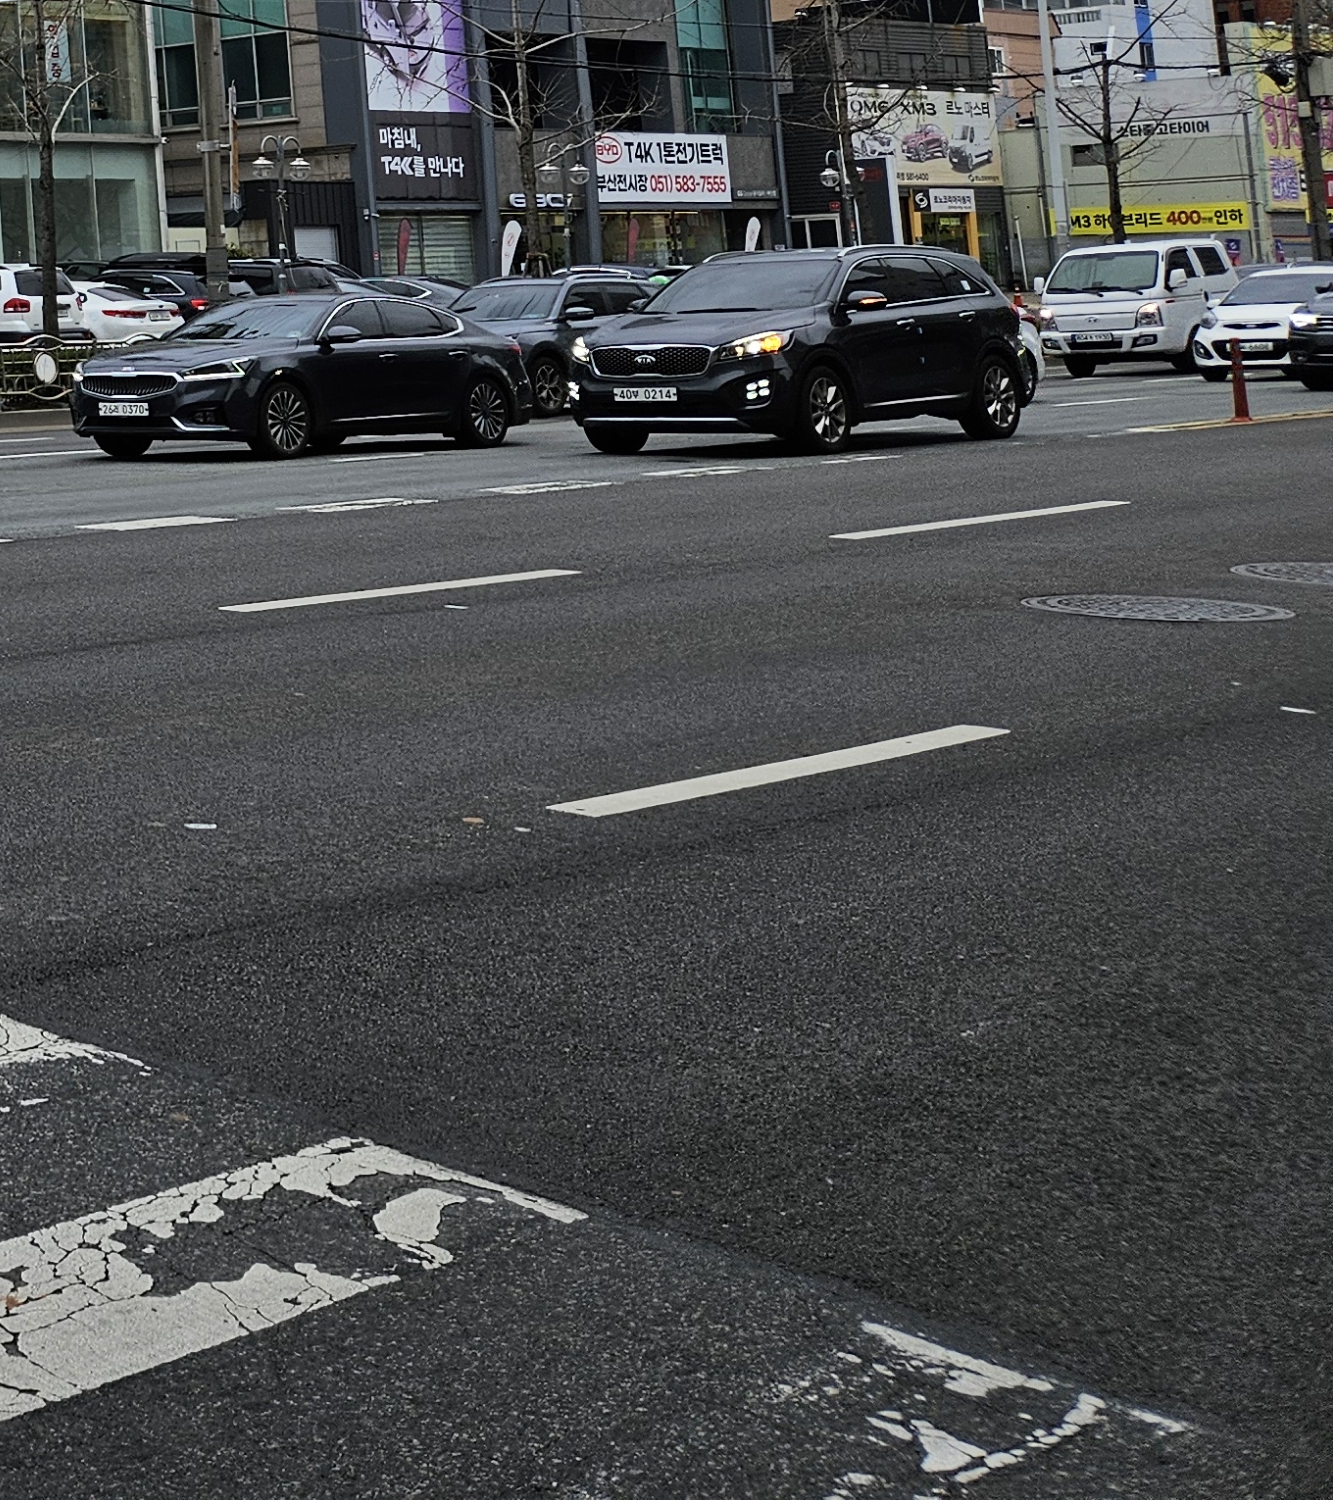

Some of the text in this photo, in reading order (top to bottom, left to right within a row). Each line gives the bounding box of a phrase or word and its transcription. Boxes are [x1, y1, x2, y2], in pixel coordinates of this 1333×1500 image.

[900, 101, 937, 116] XM3
[379, 126, 421, 152] 마침내,
[596, 144, 619, 156] BYD
[624, 141, 724, 165] T4K 1톤전기트럭
[427, 155, 465, 178] 만나다
[597, 173, 727, 193] 부산전시장 051) 583-7555
[1094, 212, 1163, 229] 하브리드
[1166, 210, 1201, 226] 400
[1214, 208, 1244, 226] 인하
[644, 389, 672, 400] 0214
[122, 404, 145, 415] 0370
